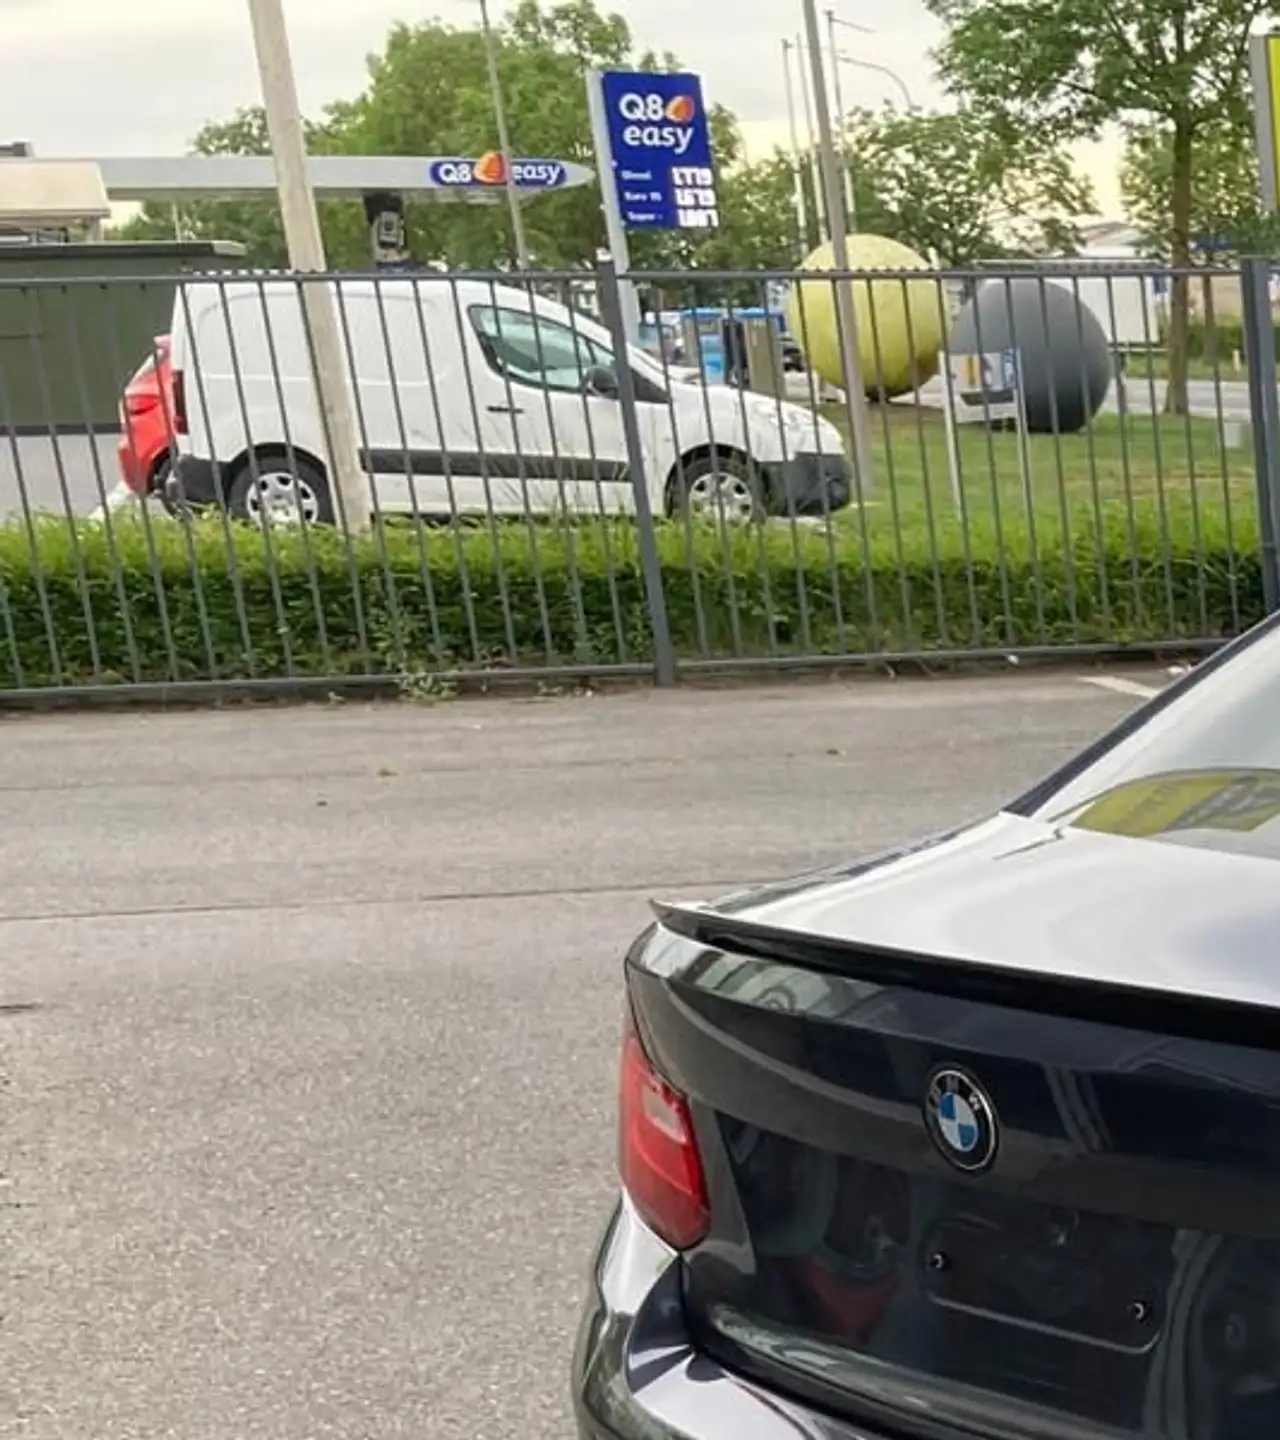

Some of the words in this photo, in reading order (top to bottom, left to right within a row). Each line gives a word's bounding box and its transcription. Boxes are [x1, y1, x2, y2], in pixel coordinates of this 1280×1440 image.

[619, 93, 664, 121] Q8
[623, 126, 694, 154] easy
[439, 164, 471, 183] Q8
[512, 164, 560, 184] easy
